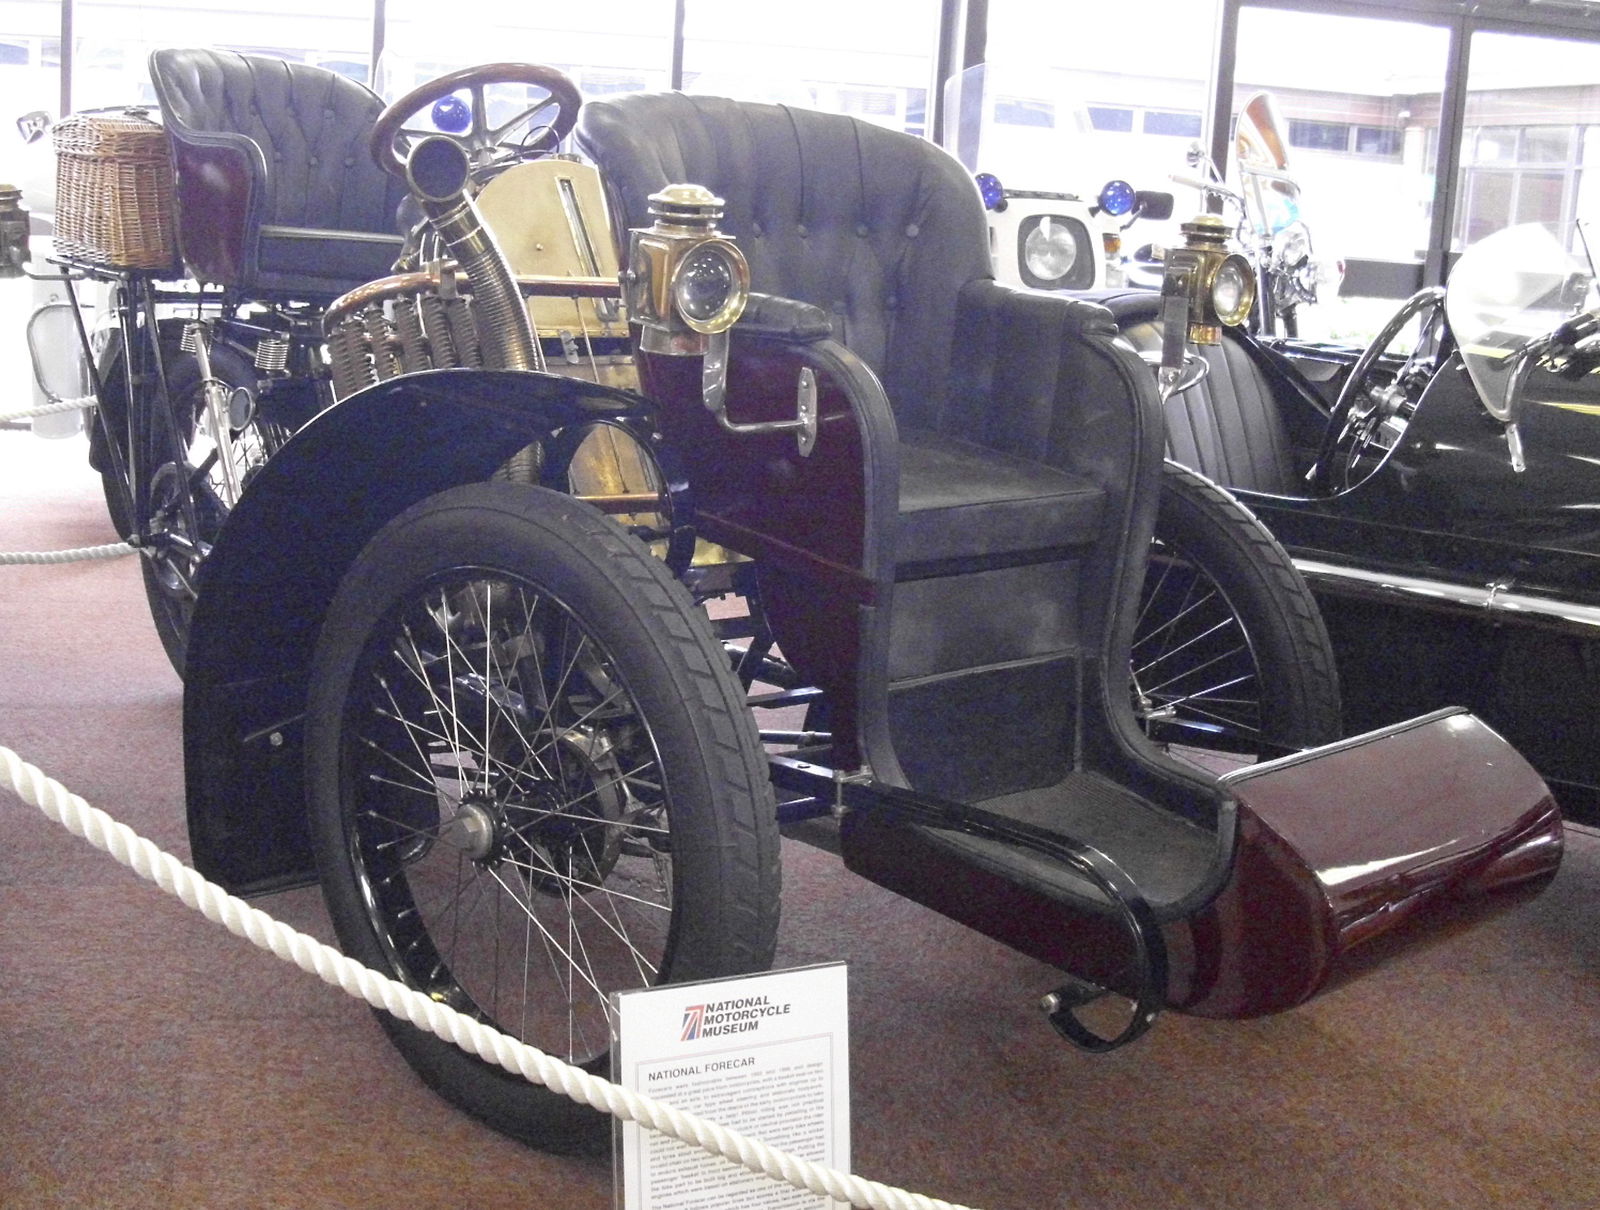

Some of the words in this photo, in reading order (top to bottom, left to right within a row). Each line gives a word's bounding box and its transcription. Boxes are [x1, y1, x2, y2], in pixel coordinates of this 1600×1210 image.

[705, 996, 770, 1013] NATIONAL
[703, 1004, 791, 1025] MOTORCYCLE
[702, 1020, 759, 1038] MUSEUM
[648, 1066, 701, 1081] NATIONAL
[705, 1057, 755, 1072] FORECAR
